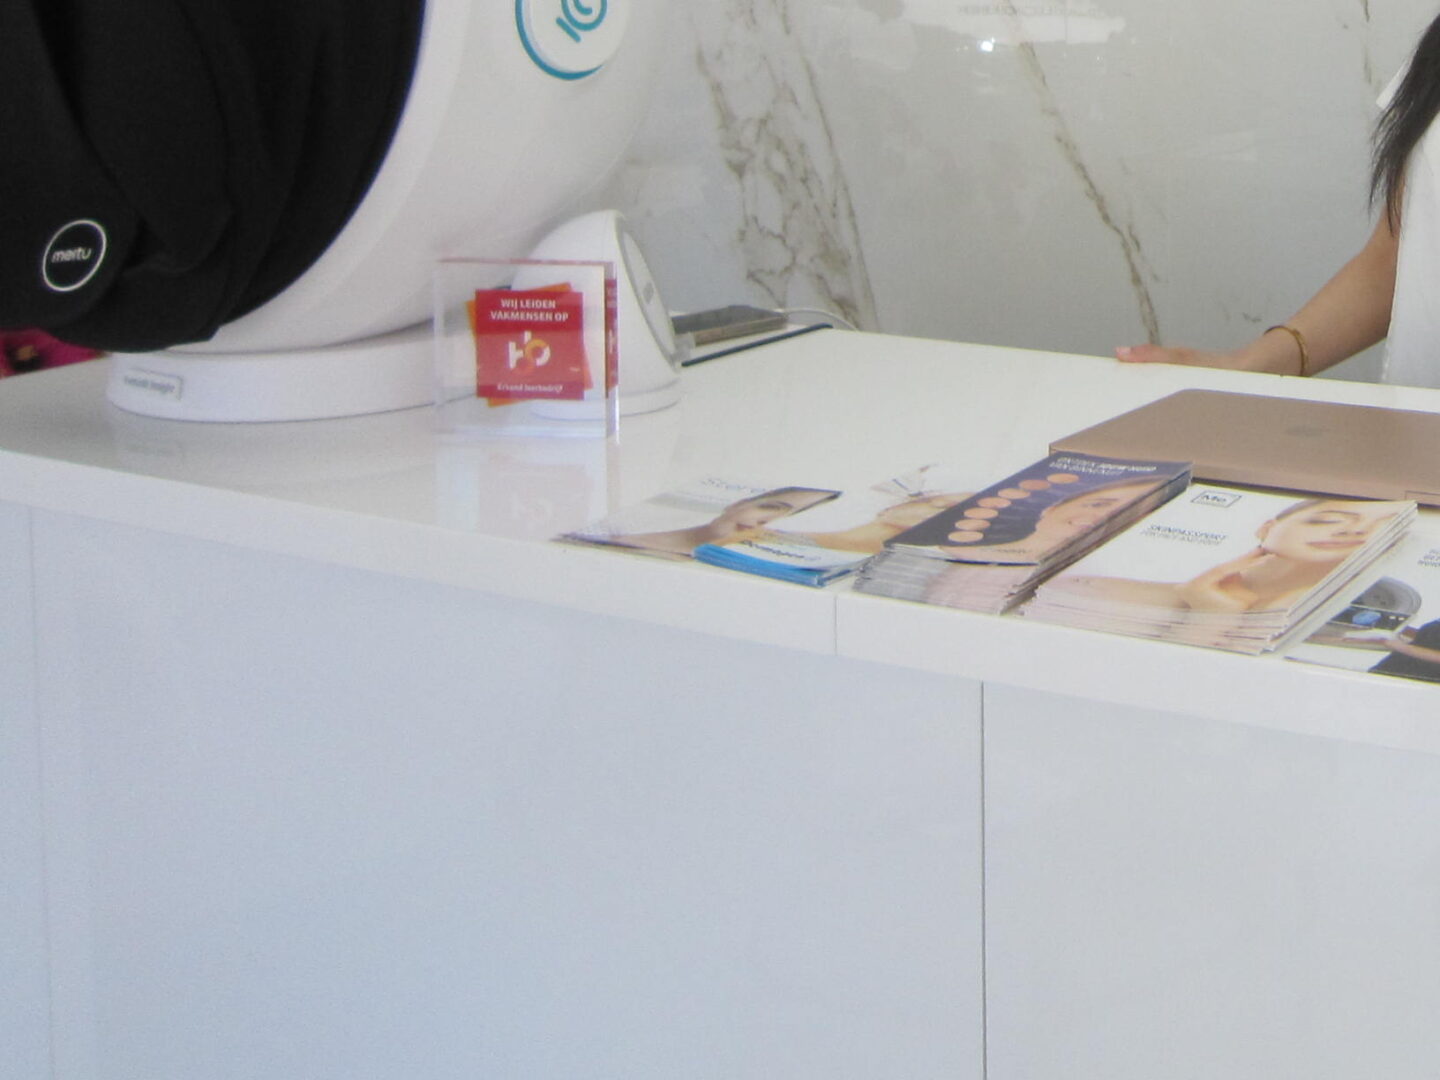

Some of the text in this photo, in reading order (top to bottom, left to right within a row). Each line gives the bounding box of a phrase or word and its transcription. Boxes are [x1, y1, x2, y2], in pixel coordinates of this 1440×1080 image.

[51, 247, 92, 263] meitu
[501, 298, 557, 309] WIJ LEIDEN
[490, 310, 569, 322] VAKMENSEN OP
